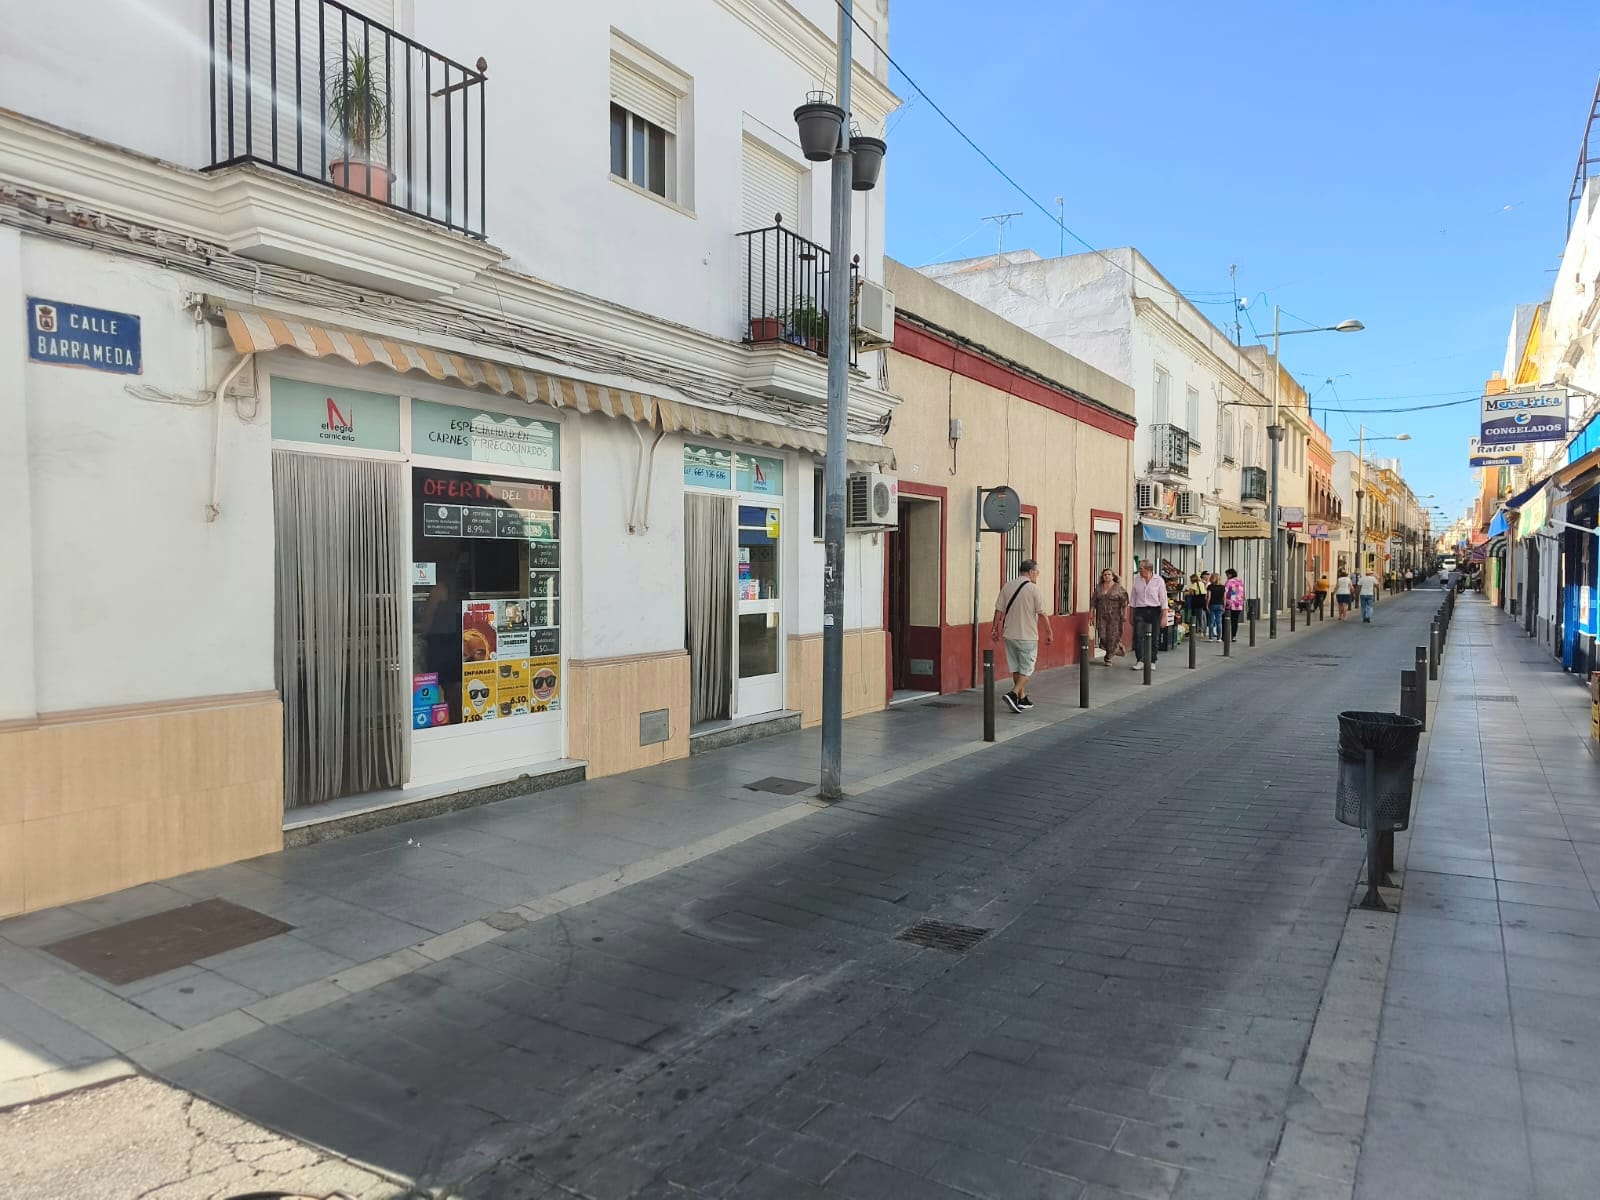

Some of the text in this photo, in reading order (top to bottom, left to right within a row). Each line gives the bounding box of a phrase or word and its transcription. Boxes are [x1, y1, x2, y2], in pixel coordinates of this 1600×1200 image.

[70, 314, 118, 335] CALLE
[38, 335, 133, 366] BARRAMEDA
[450, 419, 529, 441] ESPECIALIDAD EN
[1485, 424, 1562, 435] CONGELADOS
[428, 431, 548, 458] CARNES Y PRECOCINADOS
[1477, 444, 1516, 454] Rafael
[423, 478, 496, 500] OFERTA
[501, 489, 521, 501] DEL
[890, 497, 897, 505] LG
[464, 668, 496, 677] EMPANADA
